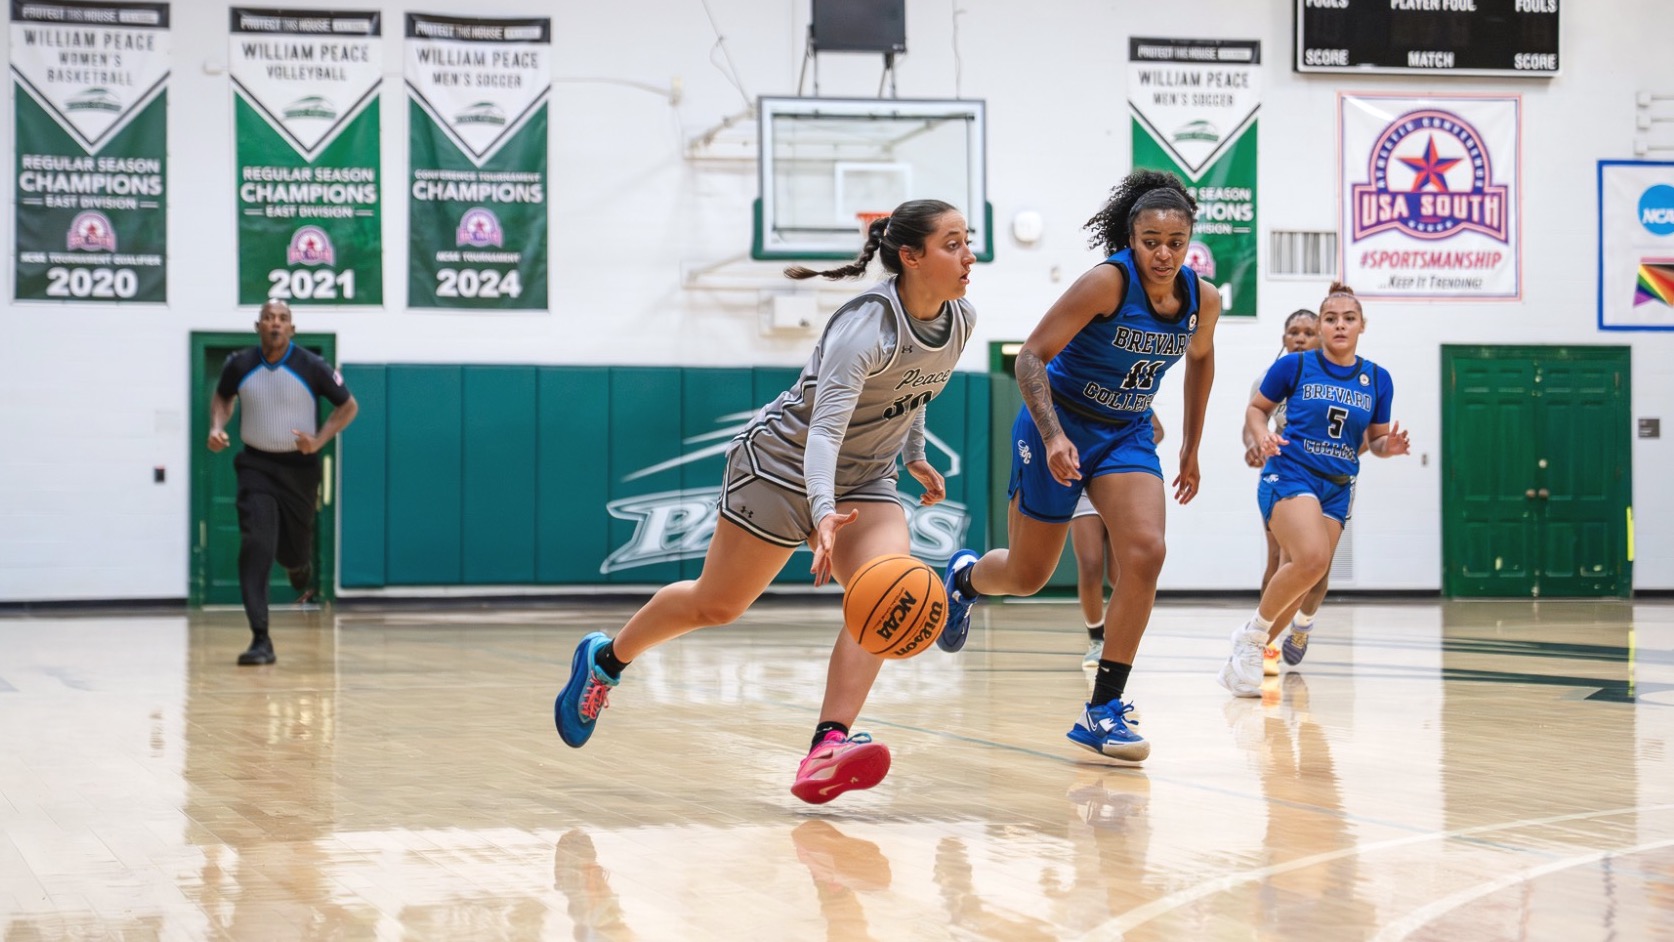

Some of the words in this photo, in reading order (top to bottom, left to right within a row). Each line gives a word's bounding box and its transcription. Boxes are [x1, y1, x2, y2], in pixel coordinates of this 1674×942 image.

[84, 9, 117, 22] HOUSE
[1515, 0, 1557, 13] FOULS
[24, 30, 95, 48] WILLIAM
[104, 33, 155, 51] PEACE
[59, 52, 121, 68] WOMEN'S
[242, 42, 313, 60] WILLIAM
[322, 44, 368, 62] PEACE
[416, 48, 486, 66] WILLIAM
[493, 52, 538, 68] PEACE
[1306, 48, 1348, 66] SCORE
[1408, 51, 1454, 68] MATCH
[1514, 53, 1556, 70] SCORE
[47, 69, 133, 86] BASKETBALL
[266, 66, 347, 80] VOLLEYBALL
[433, 74, 470, 87] MEN'S
[476, 74, 522, 88] SOCCER
[1138, 69, 1200, 88] WILLIAM
[1207, 72, 1250, 88] PEACE
[1153, 92, 1187, 106] MEN'S
[1192, 94, 1234, 107] SOCCER
[22, 154, 94, 172] REGULAR
[98, 158, 160, 174] SEASON
[19, 172, 162, 195] CHAMPIONS
[242, 166, 310, 182] REGULAR
[314, 167, 374, 182] SEASON
[415, 170, 476, 180] CONFERENCE
[479, 172, 540, 182] TOURNAMENT
[240, 184, 377, 205] CHAMPIONS
[412, 180, 543, 203] CHAMPIONS
[1199, 187, 1251, 201] SEASON
[46, 196, 76, 208] EAST
[80, 198, 136, 210] DIVISION
[266, 206, 296, 218] EAST
[300, 206, 352, 218] DIVISION
[1194, 202, 1254, 221] PIONS
[1362, 194, 1409, 227] USA
[1420, 194, 1500, 228] SOUTH
[1642, 207, 1674, 224] NCA
[49, 254, 111, 264] TOURNAMENT
[114, 255, 161, 266] QUALIFIER
[463, 252, 520, 262] TOURNAMENT
[1360, 250, 1502, 269] #SPORTSMANSHIP
[46, 267, 138, 298] 2020
[268, 269, 354, 299] 2021
[436, 268, 522, 298] 2024
[1112, 326, 1193, 356] BREVAR
[894, 368, 950, 391] Peace
[1120, 360, 1166, 390] 11
[1302, 384, 1372, 412] BREVARD
[1326, 405, 1349, 438] 5
[876, 590, 917, 640] NCAA
[893, 601, 943, 656] Wilson
